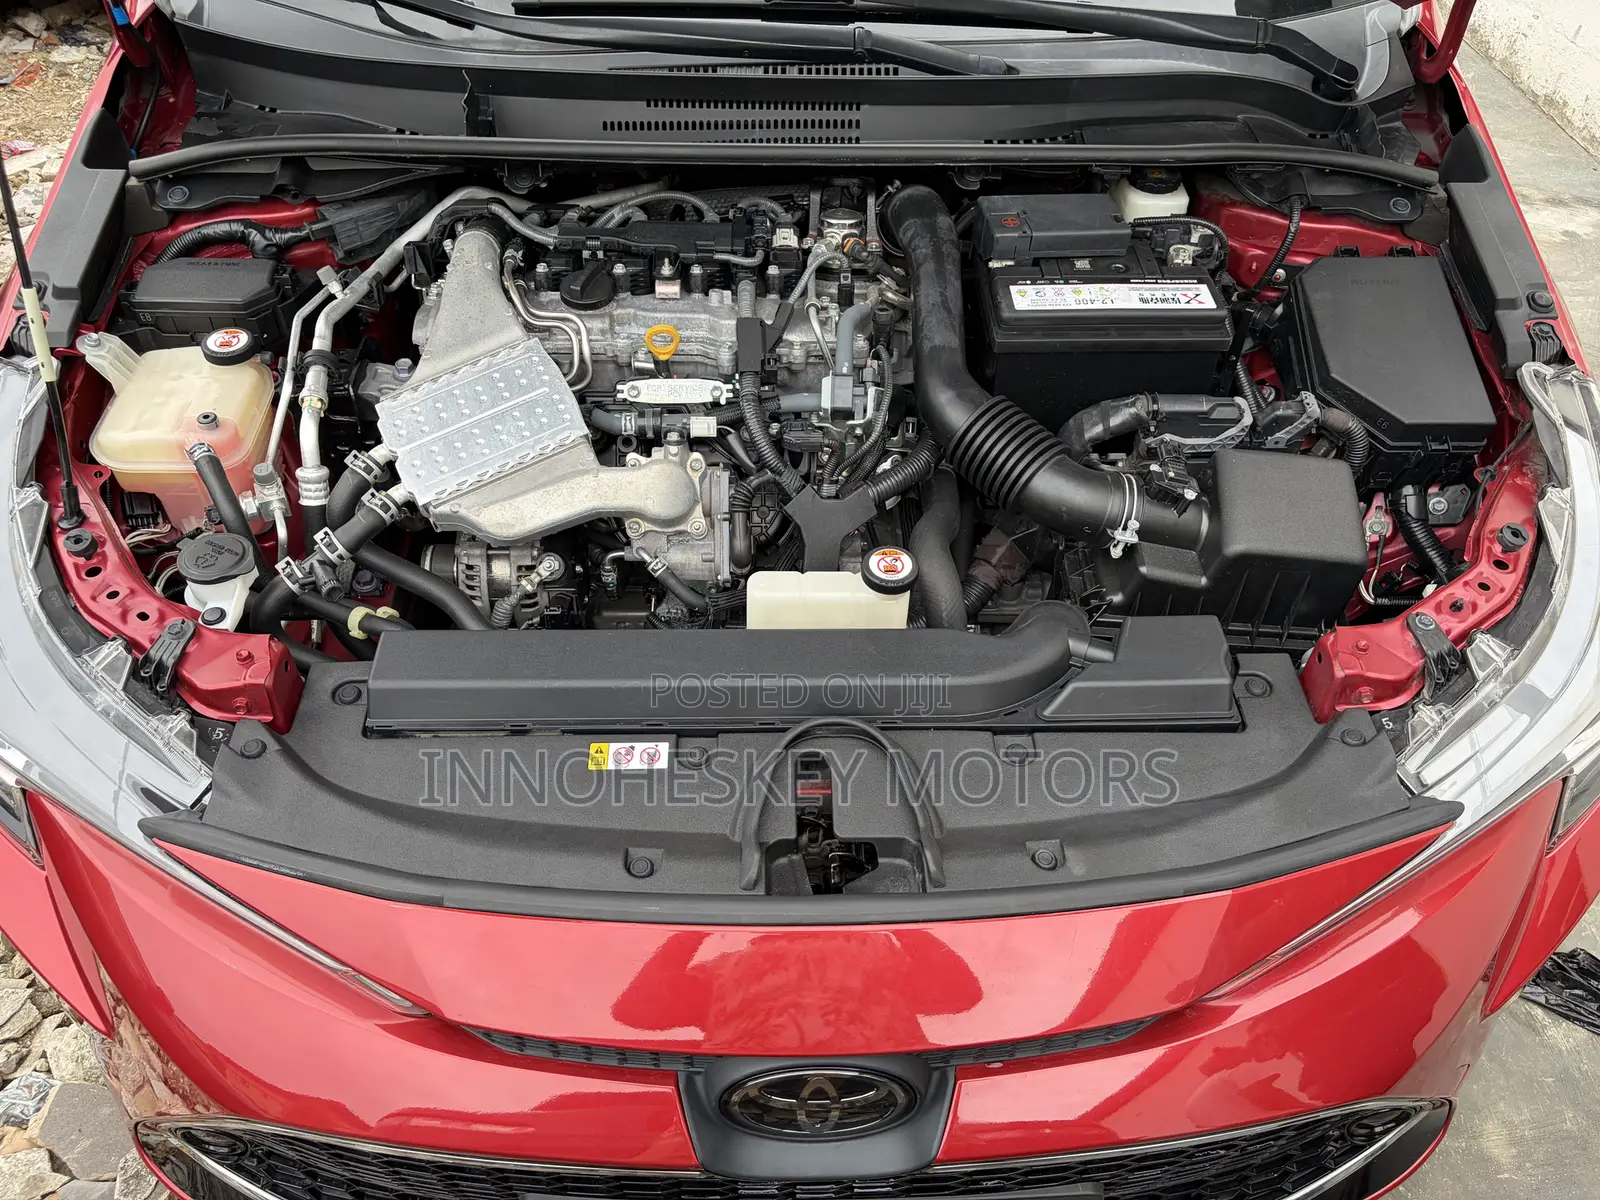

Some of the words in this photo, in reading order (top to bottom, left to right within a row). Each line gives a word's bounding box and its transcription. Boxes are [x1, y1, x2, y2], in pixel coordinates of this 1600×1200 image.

[139, 313, 152, 322] E8
[1376, 417, 1389, 430] E6
[1381, 717, 1393, 729] 5
[212, 727, 225, 739] 5
